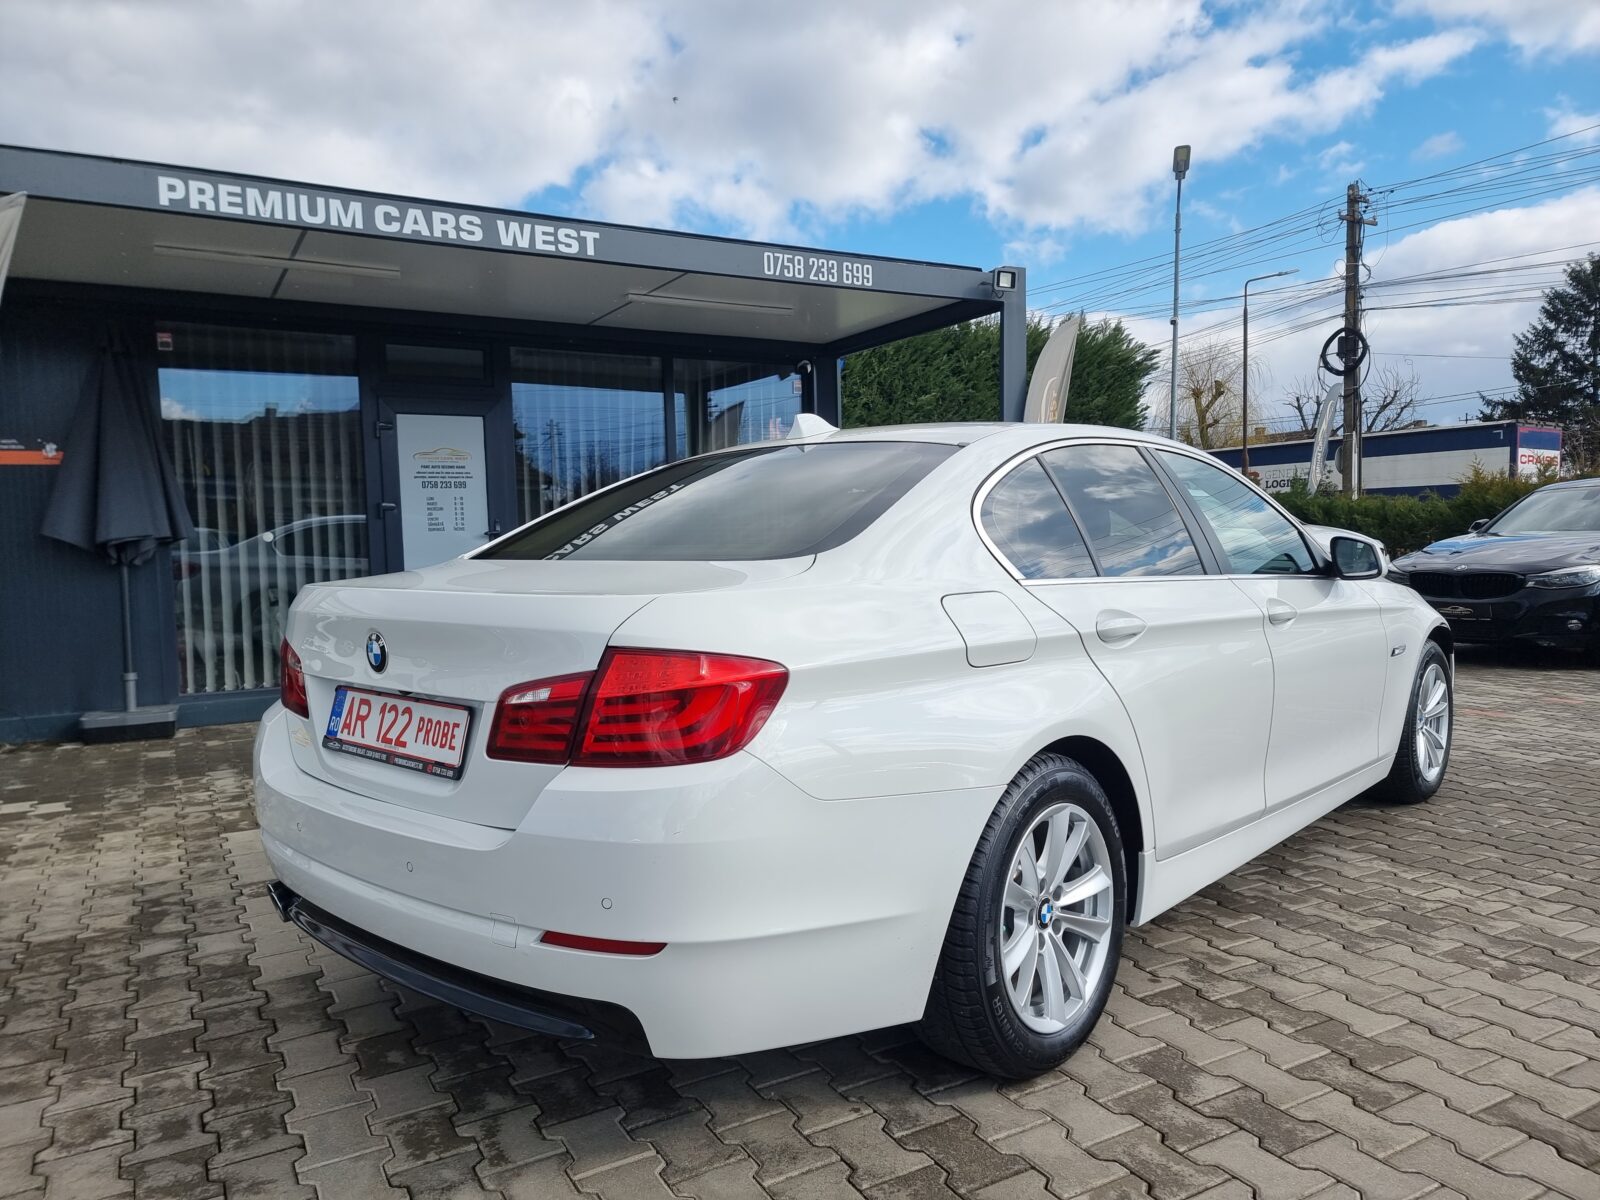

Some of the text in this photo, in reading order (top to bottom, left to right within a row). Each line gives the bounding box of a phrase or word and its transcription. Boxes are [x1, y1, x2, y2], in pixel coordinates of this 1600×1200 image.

[157, 175, 600, 257] PREMIUM CARS WEST
[763, 251, 873, 287] 0758 233 699
[421, 480, 467, 489] 0758 233 699
[329, 715, 341, 732] RO
[341, 697, 460, 751] AR 122 PROBE
